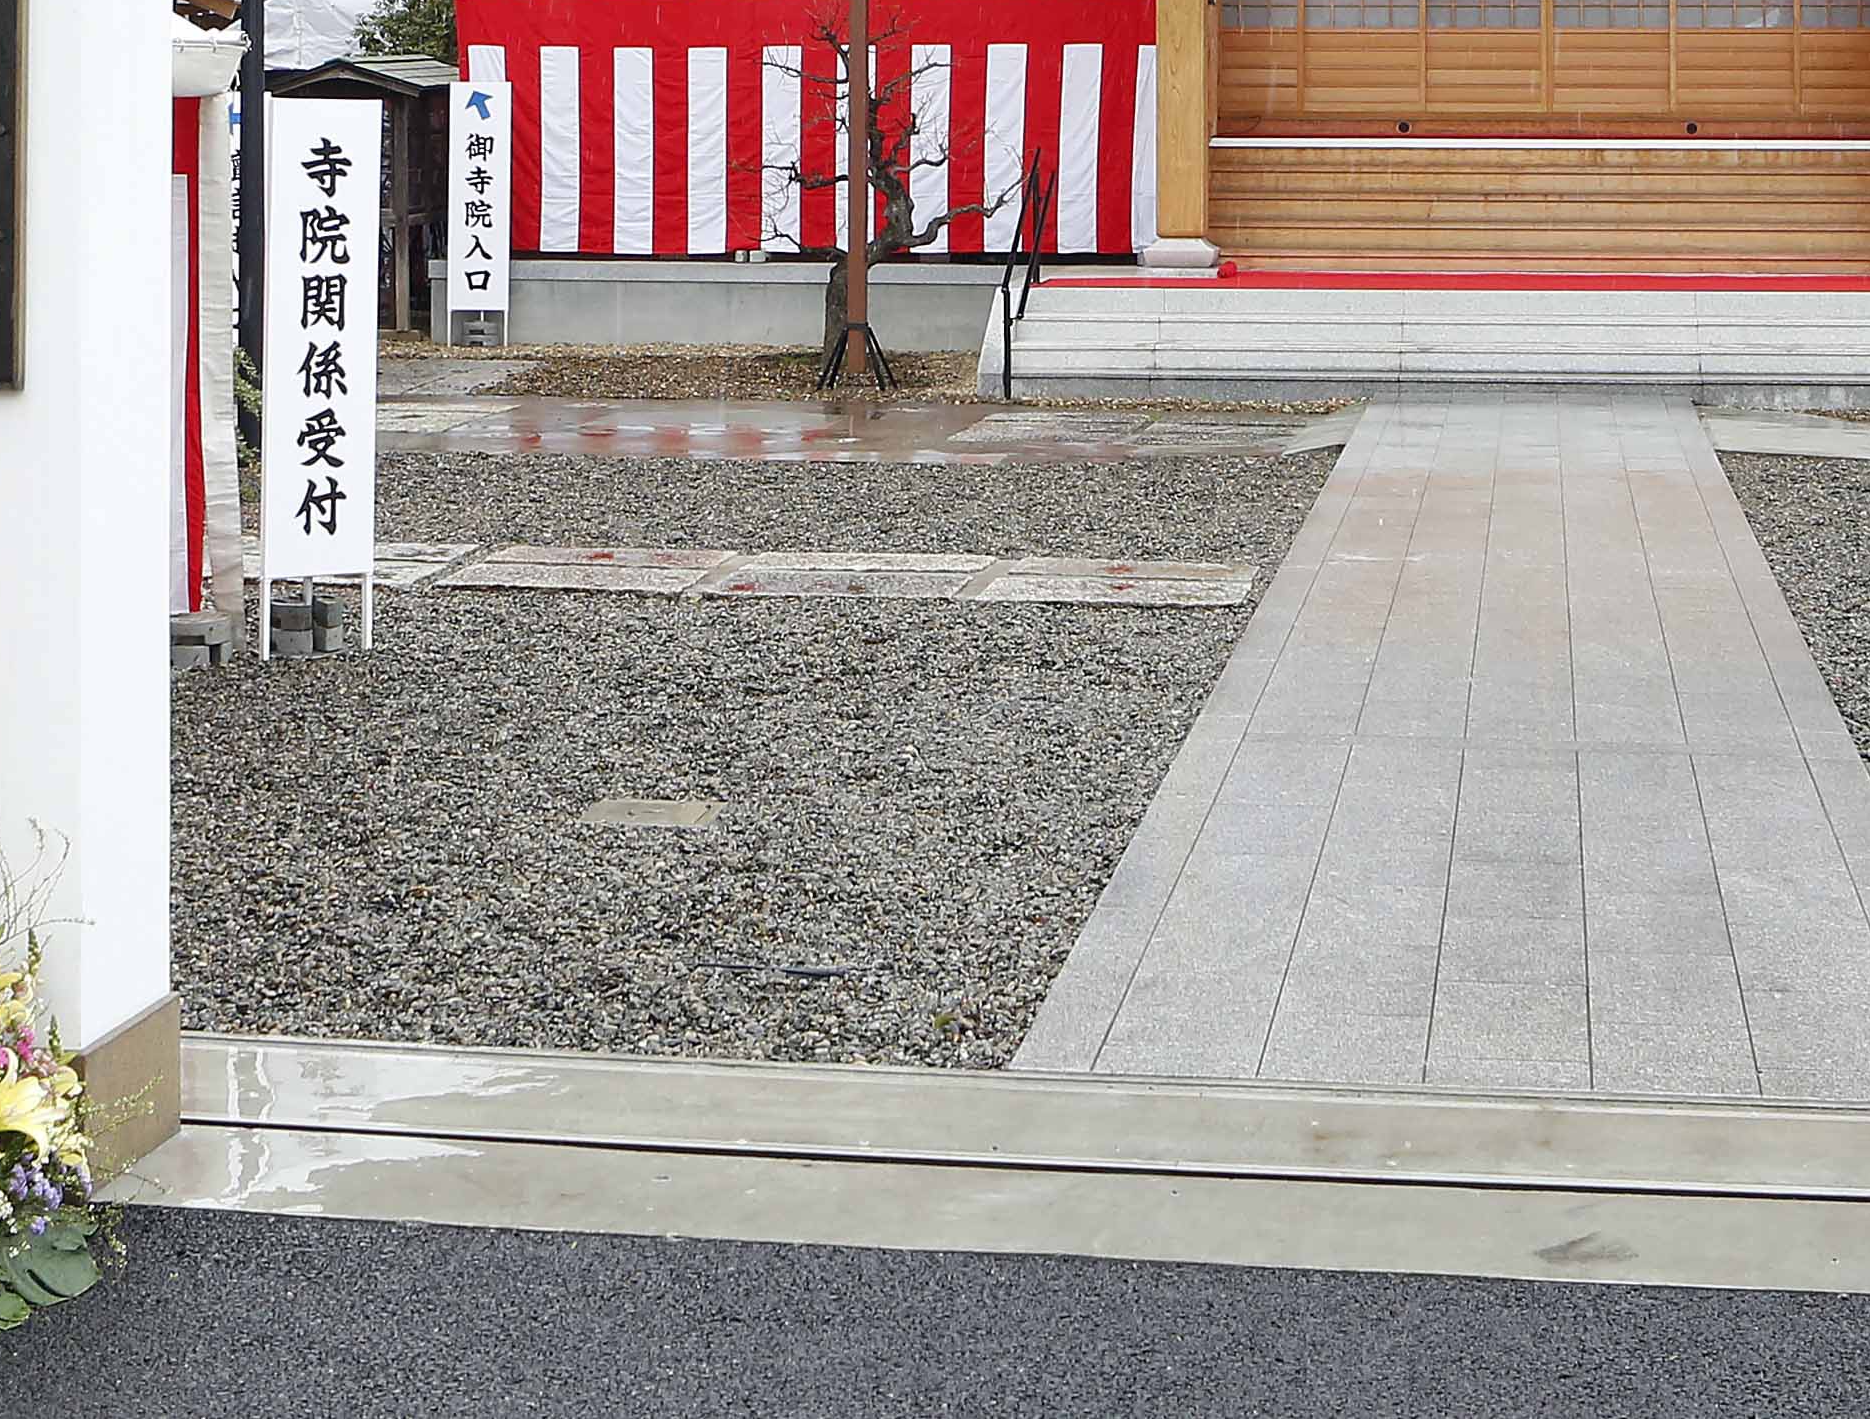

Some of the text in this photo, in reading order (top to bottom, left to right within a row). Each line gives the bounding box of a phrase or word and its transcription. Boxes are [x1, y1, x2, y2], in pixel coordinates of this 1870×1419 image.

[296, 137, 353, 536] 寺院関係受付
[464, 133, 495, 291] 御寺院入口
